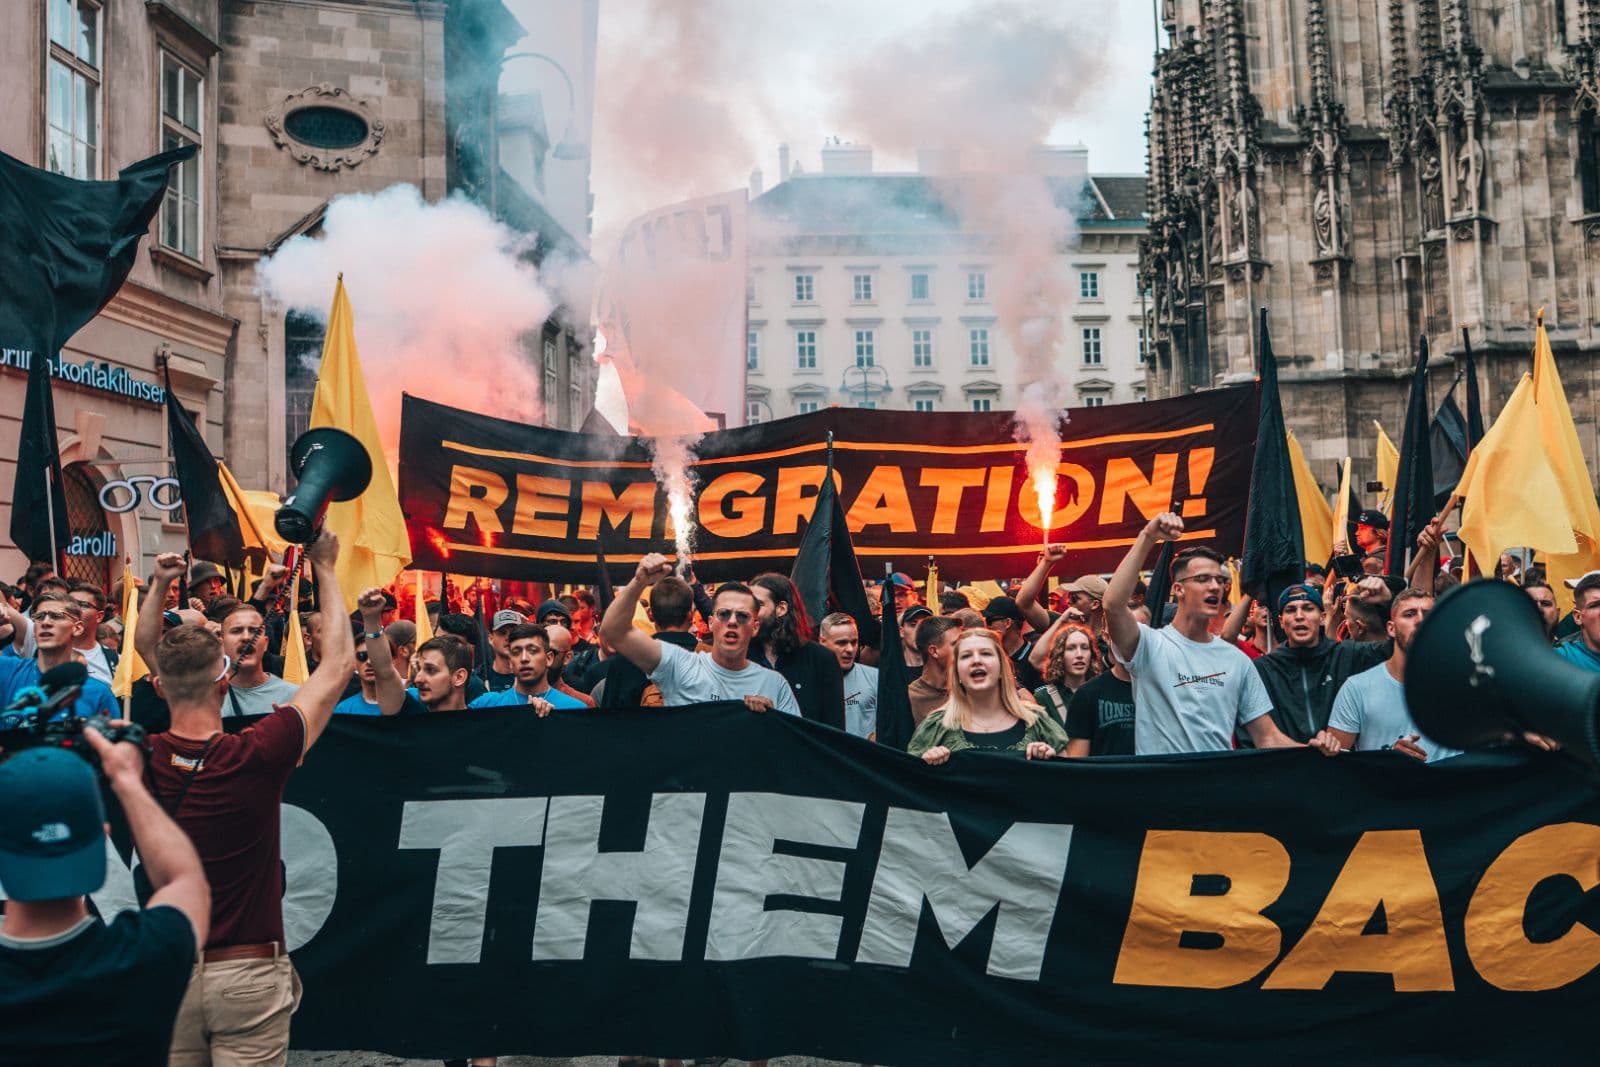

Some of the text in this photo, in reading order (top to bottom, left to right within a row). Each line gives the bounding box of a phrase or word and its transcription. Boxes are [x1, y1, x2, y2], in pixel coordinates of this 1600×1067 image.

[443, 447, 1215, 540] REMGRATION!
[67, 531, 116, 557] arolli
[398, 792, 1074, 982] THEM
[1112, 821, 1600, 992] BAC
